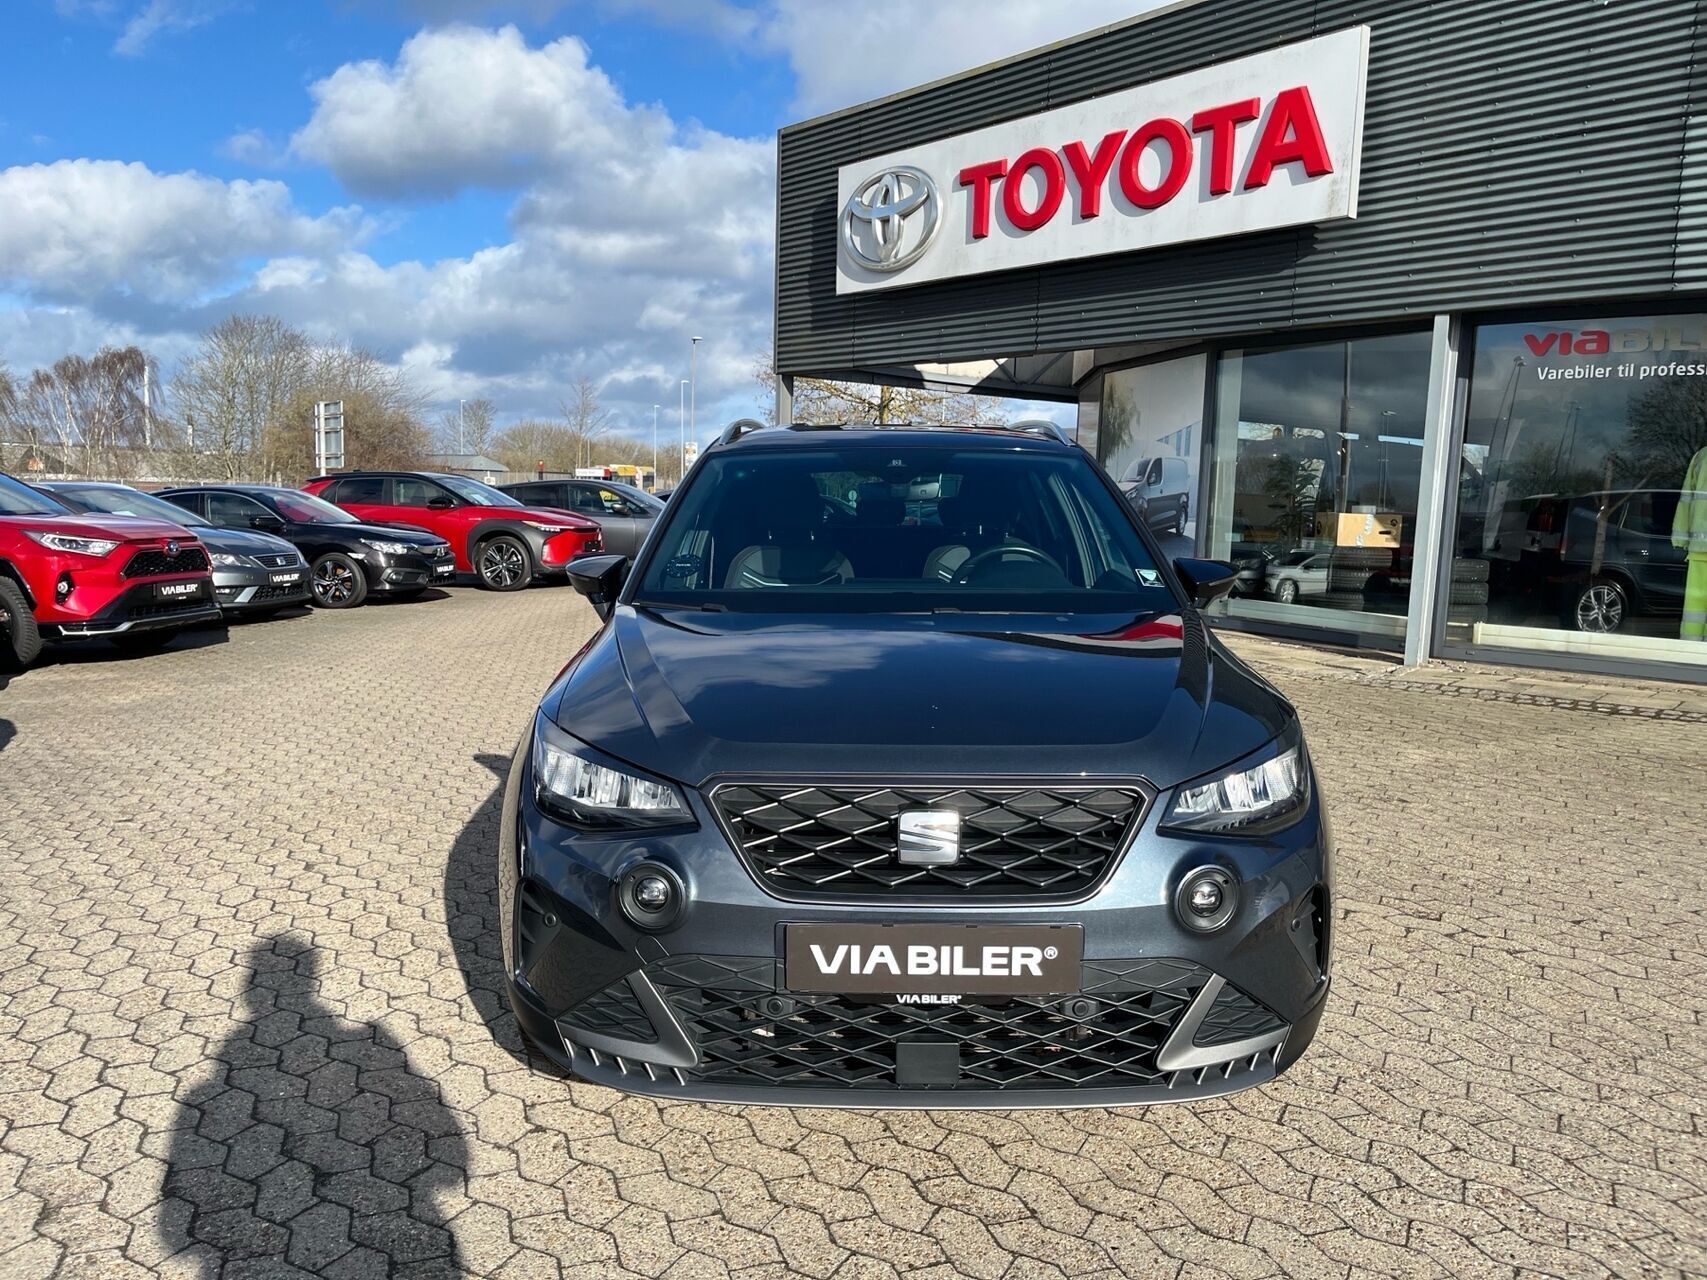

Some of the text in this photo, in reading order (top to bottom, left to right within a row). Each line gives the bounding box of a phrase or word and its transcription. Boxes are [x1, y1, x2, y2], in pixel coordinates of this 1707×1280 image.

[959, 85, 1334, 239] TOYOTA
[1537, 364, 1612, 381] Varebiler
[1617, 363, 1634, 378] til
[161, 585, 176, 596] VIA
[809, 944, 901, 975] VIA
[896, 994, 920, 1004] VIA
